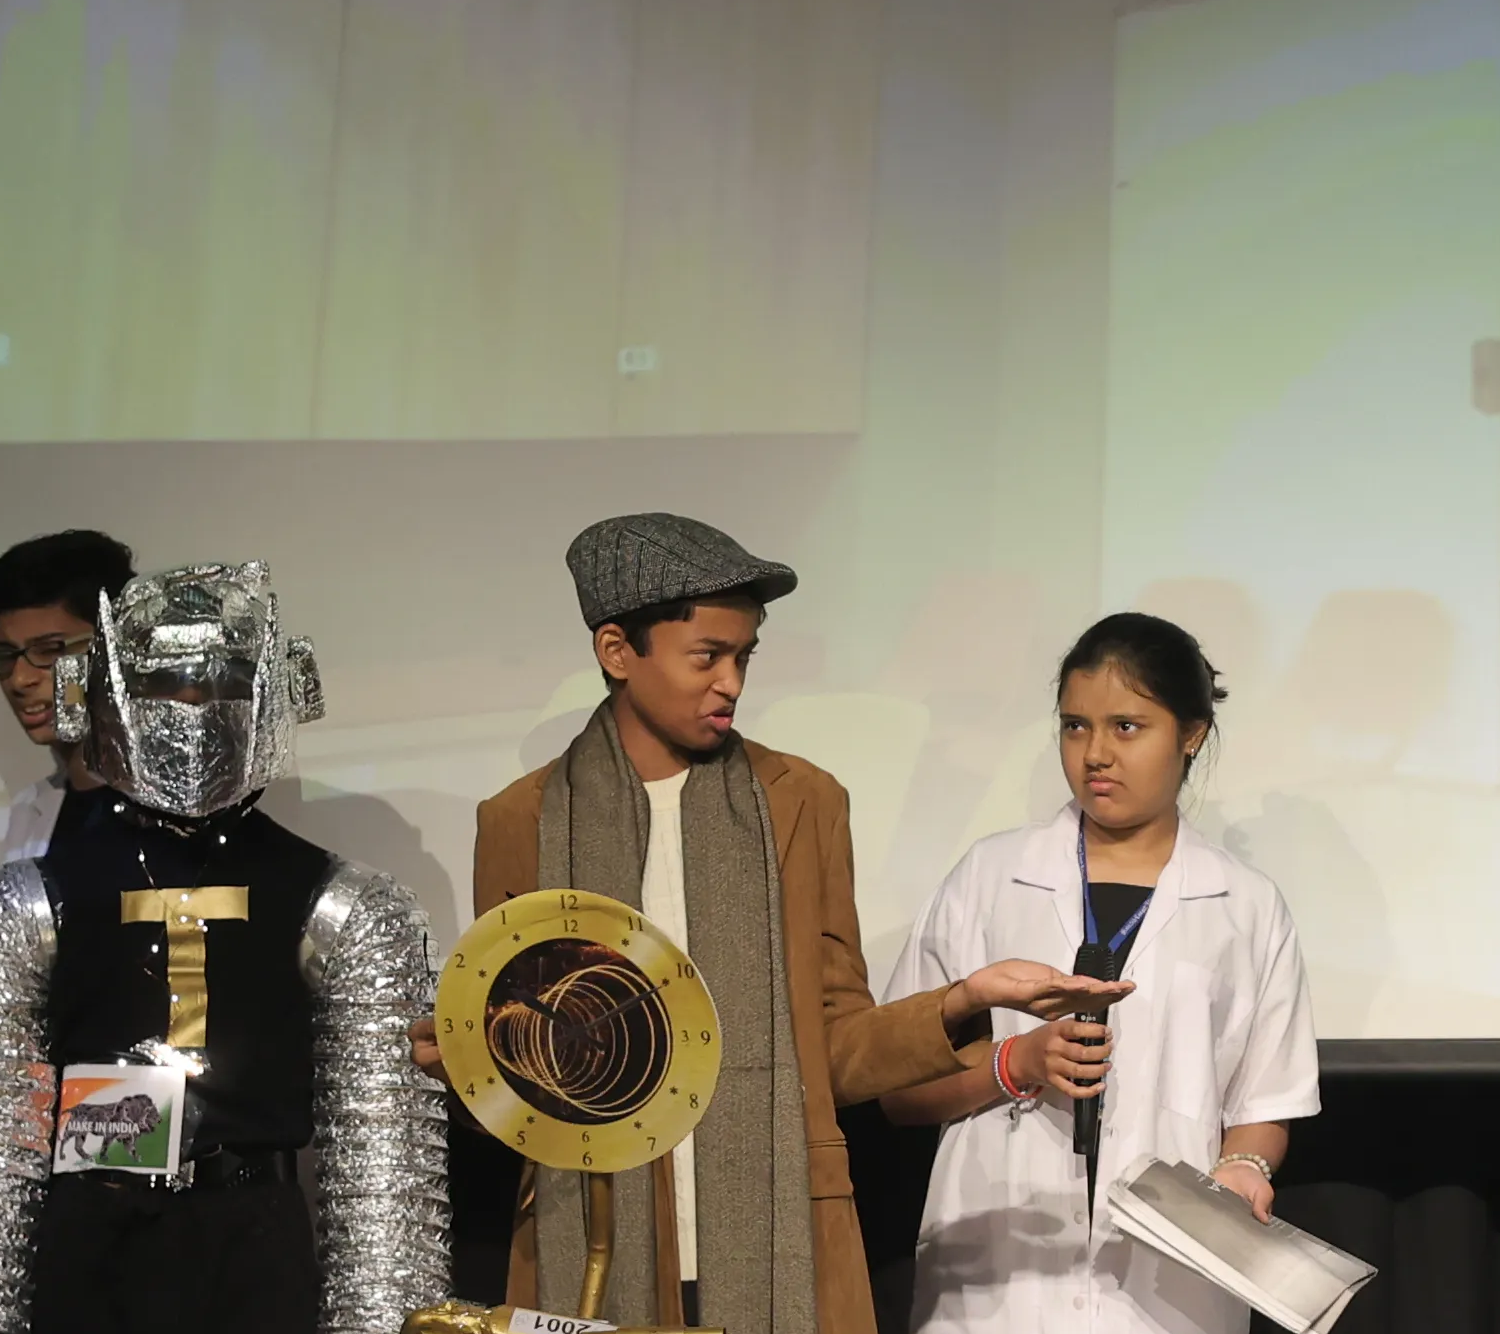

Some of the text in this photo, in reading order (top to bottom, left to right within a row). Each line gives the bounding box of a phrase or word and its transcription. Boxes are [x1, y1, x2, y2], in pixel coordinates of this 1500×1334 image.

[559, 894, 580, 911] 12
[563, 920, 580, 934] 12
[627, 916, 644, 933] 11
[454, 953, 466, 969] 2
[676, 962, 695, 980] 10
[443, 1018, 455, 1034] 3
[465, 1019, 474, 1033] 9
[680, 1029, 690, 1043] 3
[700, 1030, 711, 1046] 9
[465, 1082, 476, 1098] 4
[688, 1094, 699, 1109] 8
[67, 1120, 141, 1134] MAKE IN INDIA
[516, 1130, 527, 1146] 5
[581, 1131, 590, 1144] 6
[646, 1136, 657, 1152] 7
[582, 1151, 593, 1166] 6
